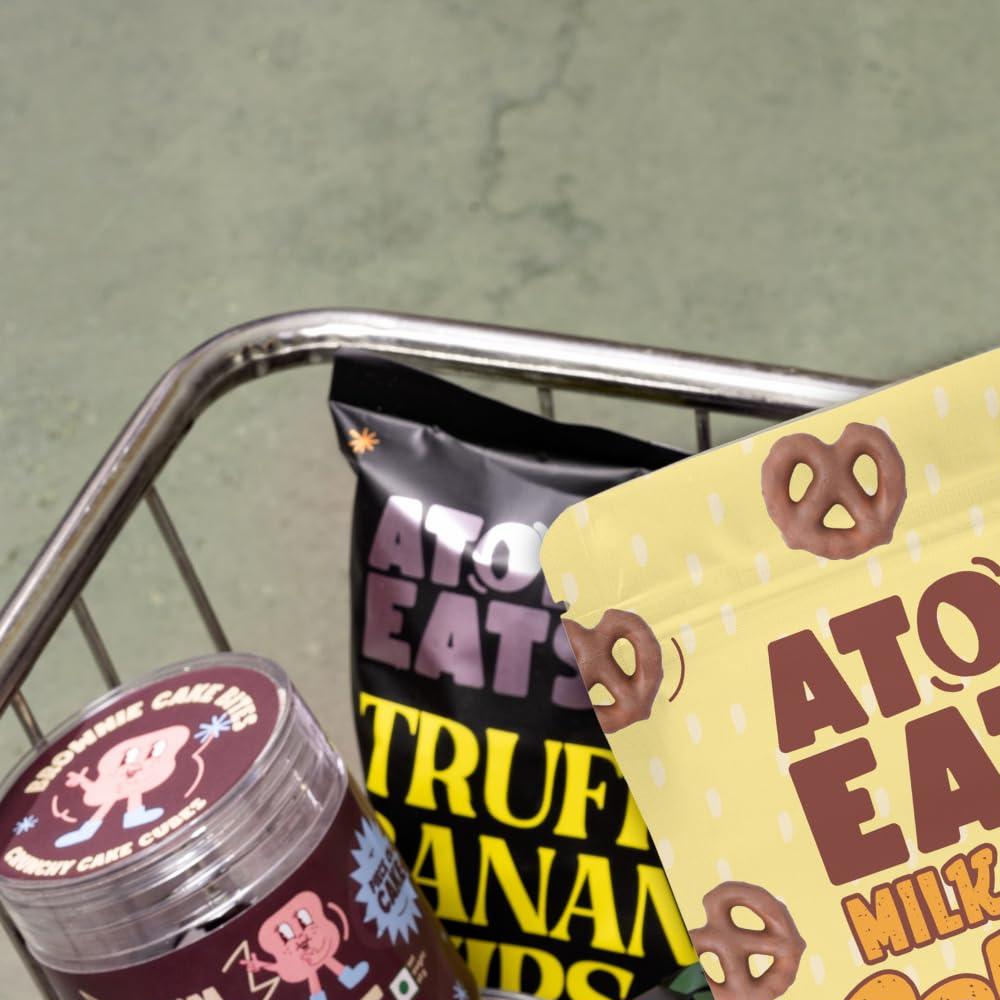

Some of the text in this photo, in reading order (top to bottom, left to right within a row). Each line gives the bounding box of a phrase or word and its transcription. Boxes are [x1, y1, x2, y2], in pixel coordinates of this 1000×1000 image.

[369, 496, 562, 606] ATO
[24, 683, 258, 794] BROWNIE CAKE BITES
[4, 797, 207, 876] CRUNCHY CAKE CUBES
